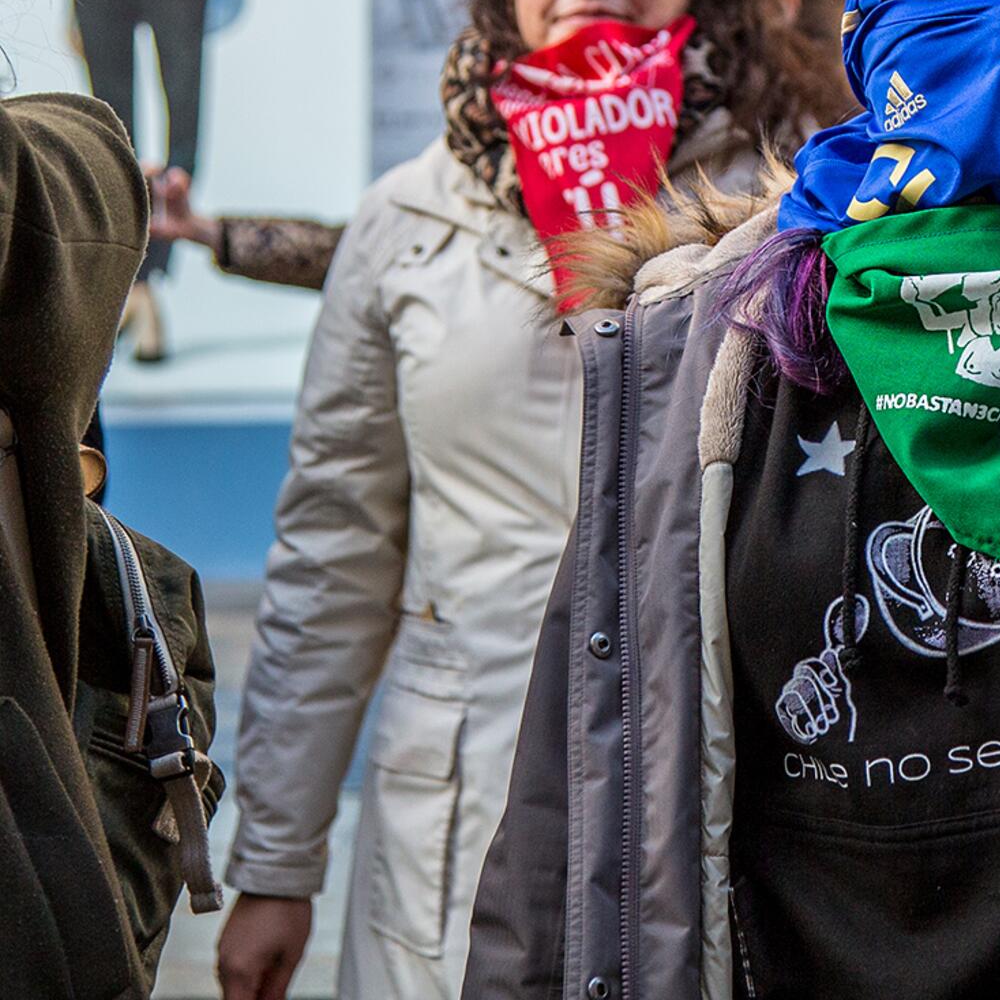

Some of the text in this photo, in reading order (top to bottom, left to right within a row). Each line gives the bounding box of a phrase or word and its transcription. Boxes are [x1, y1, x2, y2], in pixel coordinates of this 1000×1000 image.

[884, 94, 927, 132] adidas
[538, 140, 609, 179] res
[866, 753, 931, 787] no
